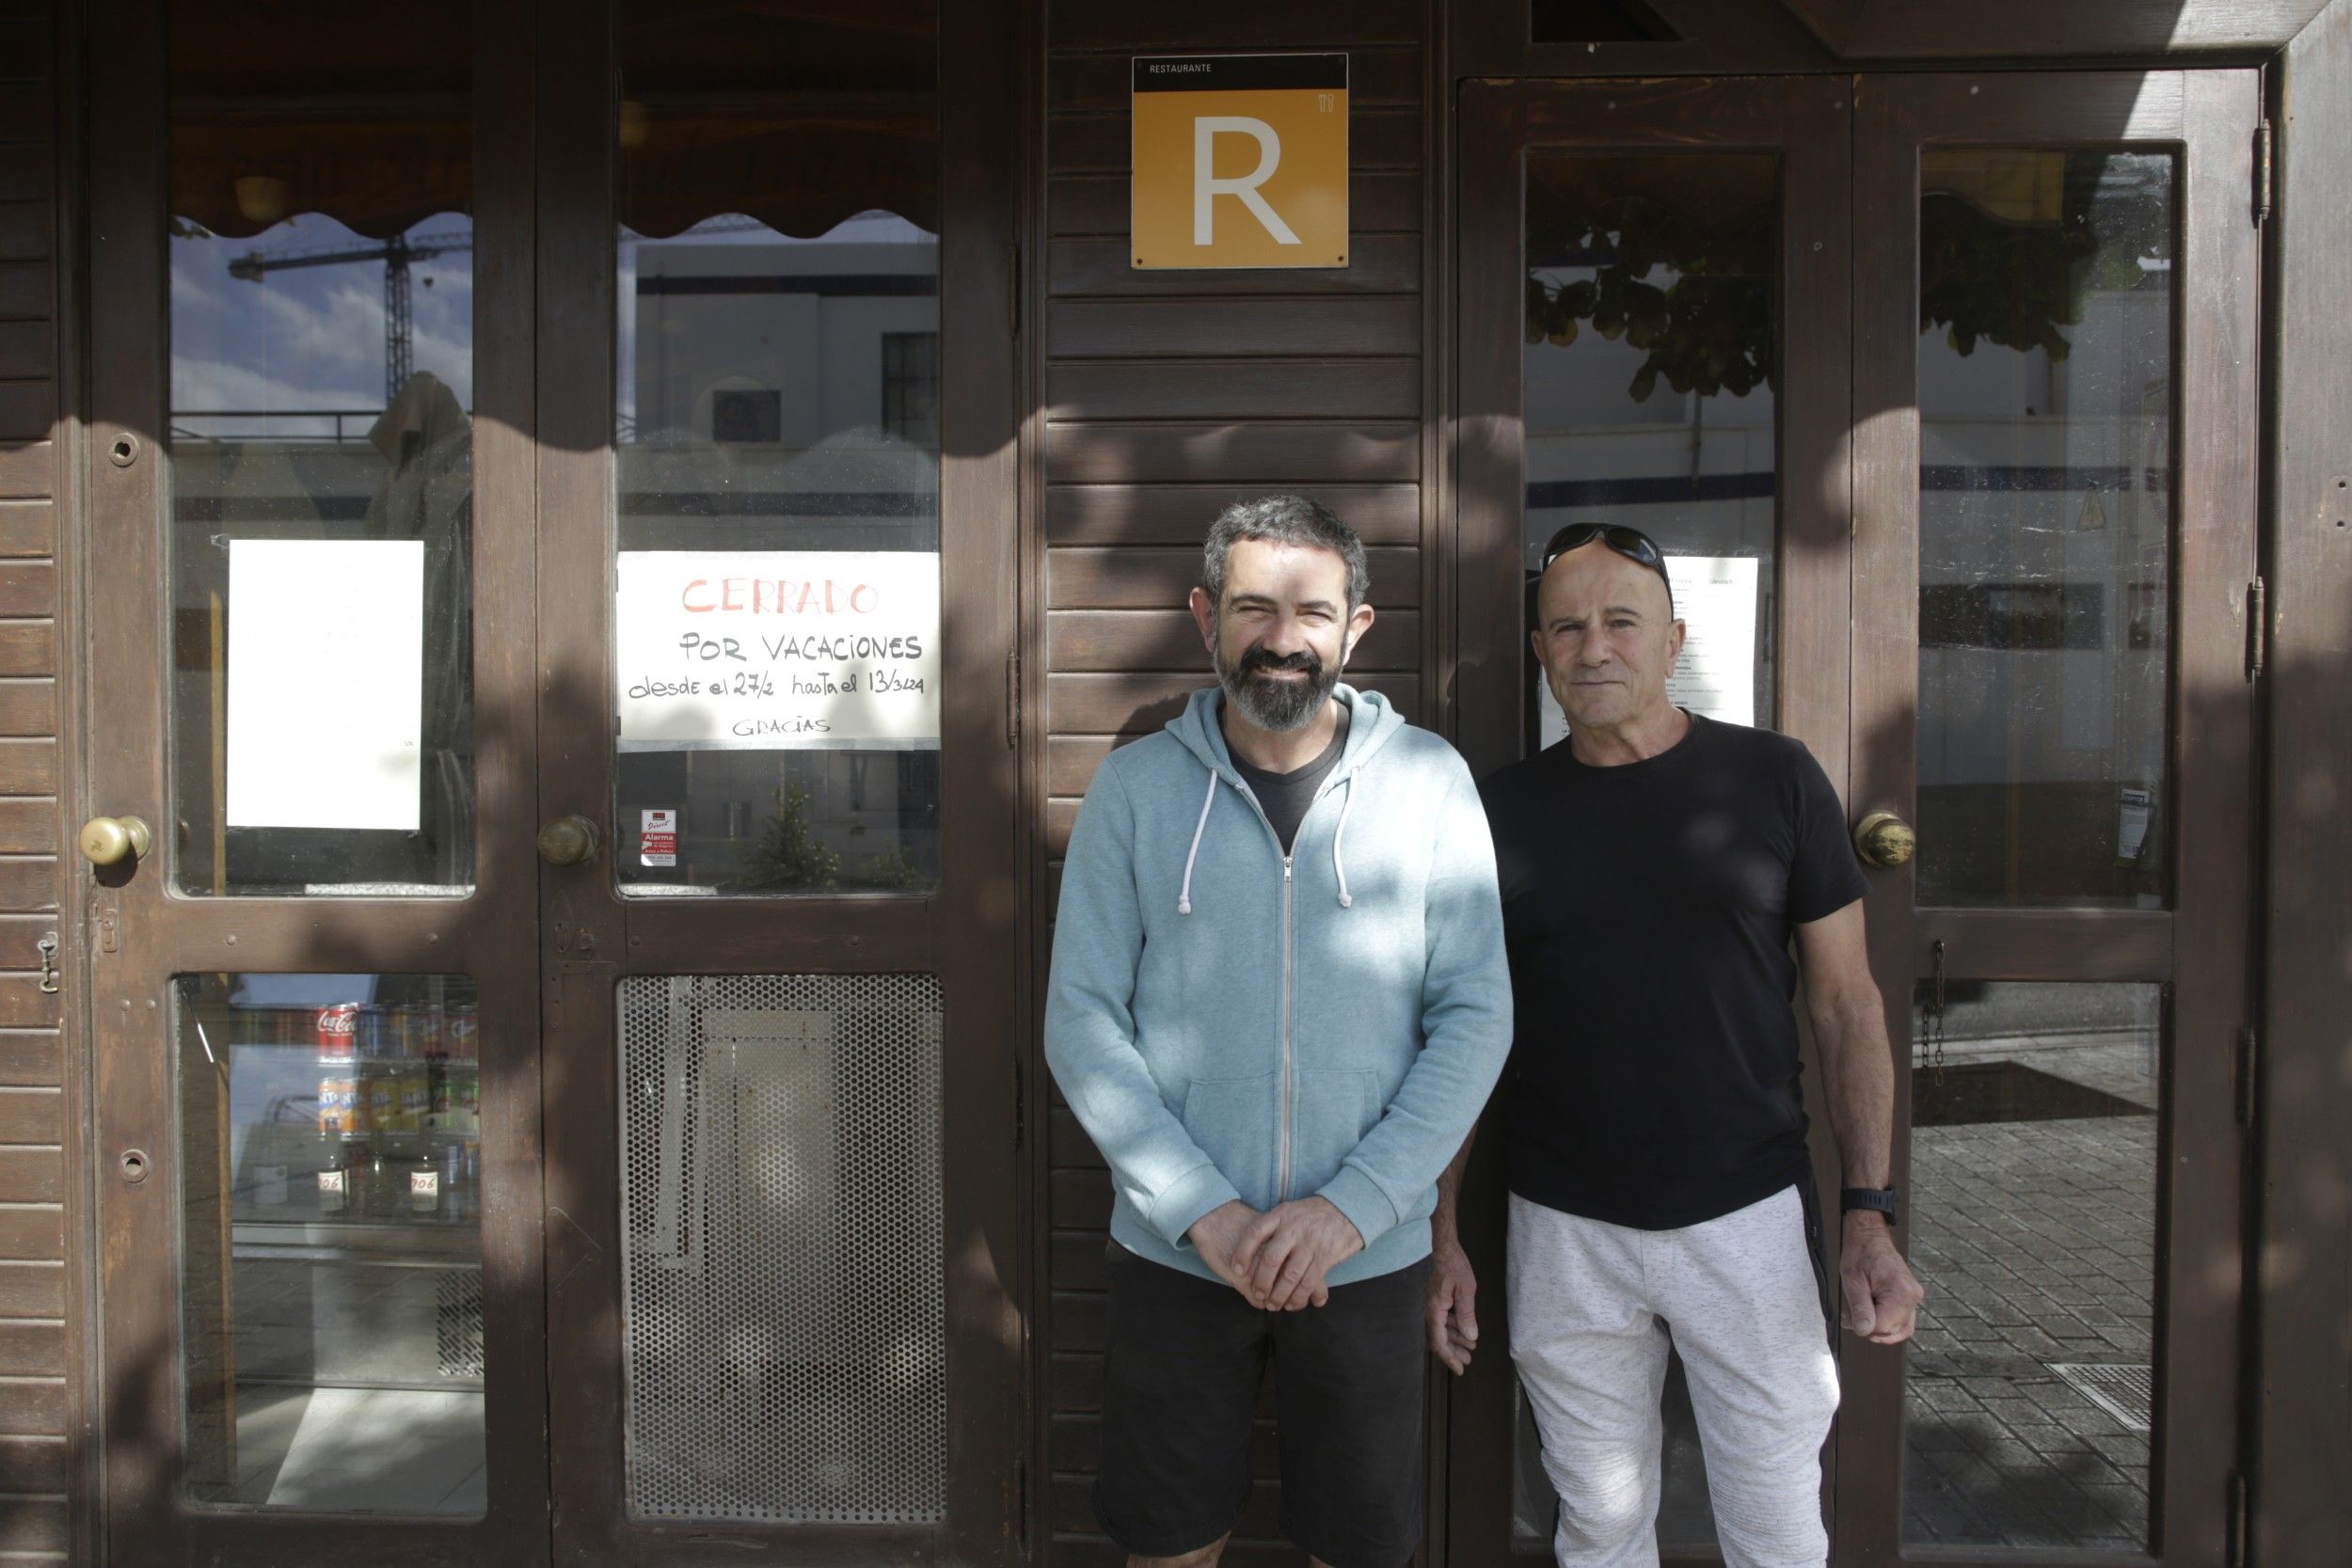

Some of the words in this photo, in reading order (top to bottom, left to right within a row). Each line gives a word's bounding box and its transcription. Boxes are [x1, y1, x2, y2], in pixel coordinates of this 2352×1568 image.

[1150, 63, 1212, 73] RESTAURANTE
[1194, 117, 1302, 245] R
[682, 578, 879, 615] CERRADO
[679, 632, 747, 662] POR
[709, 683, 728, 695] el
[733, 671, 774, 699] 27/2
[841, 673, 858, 693] el
